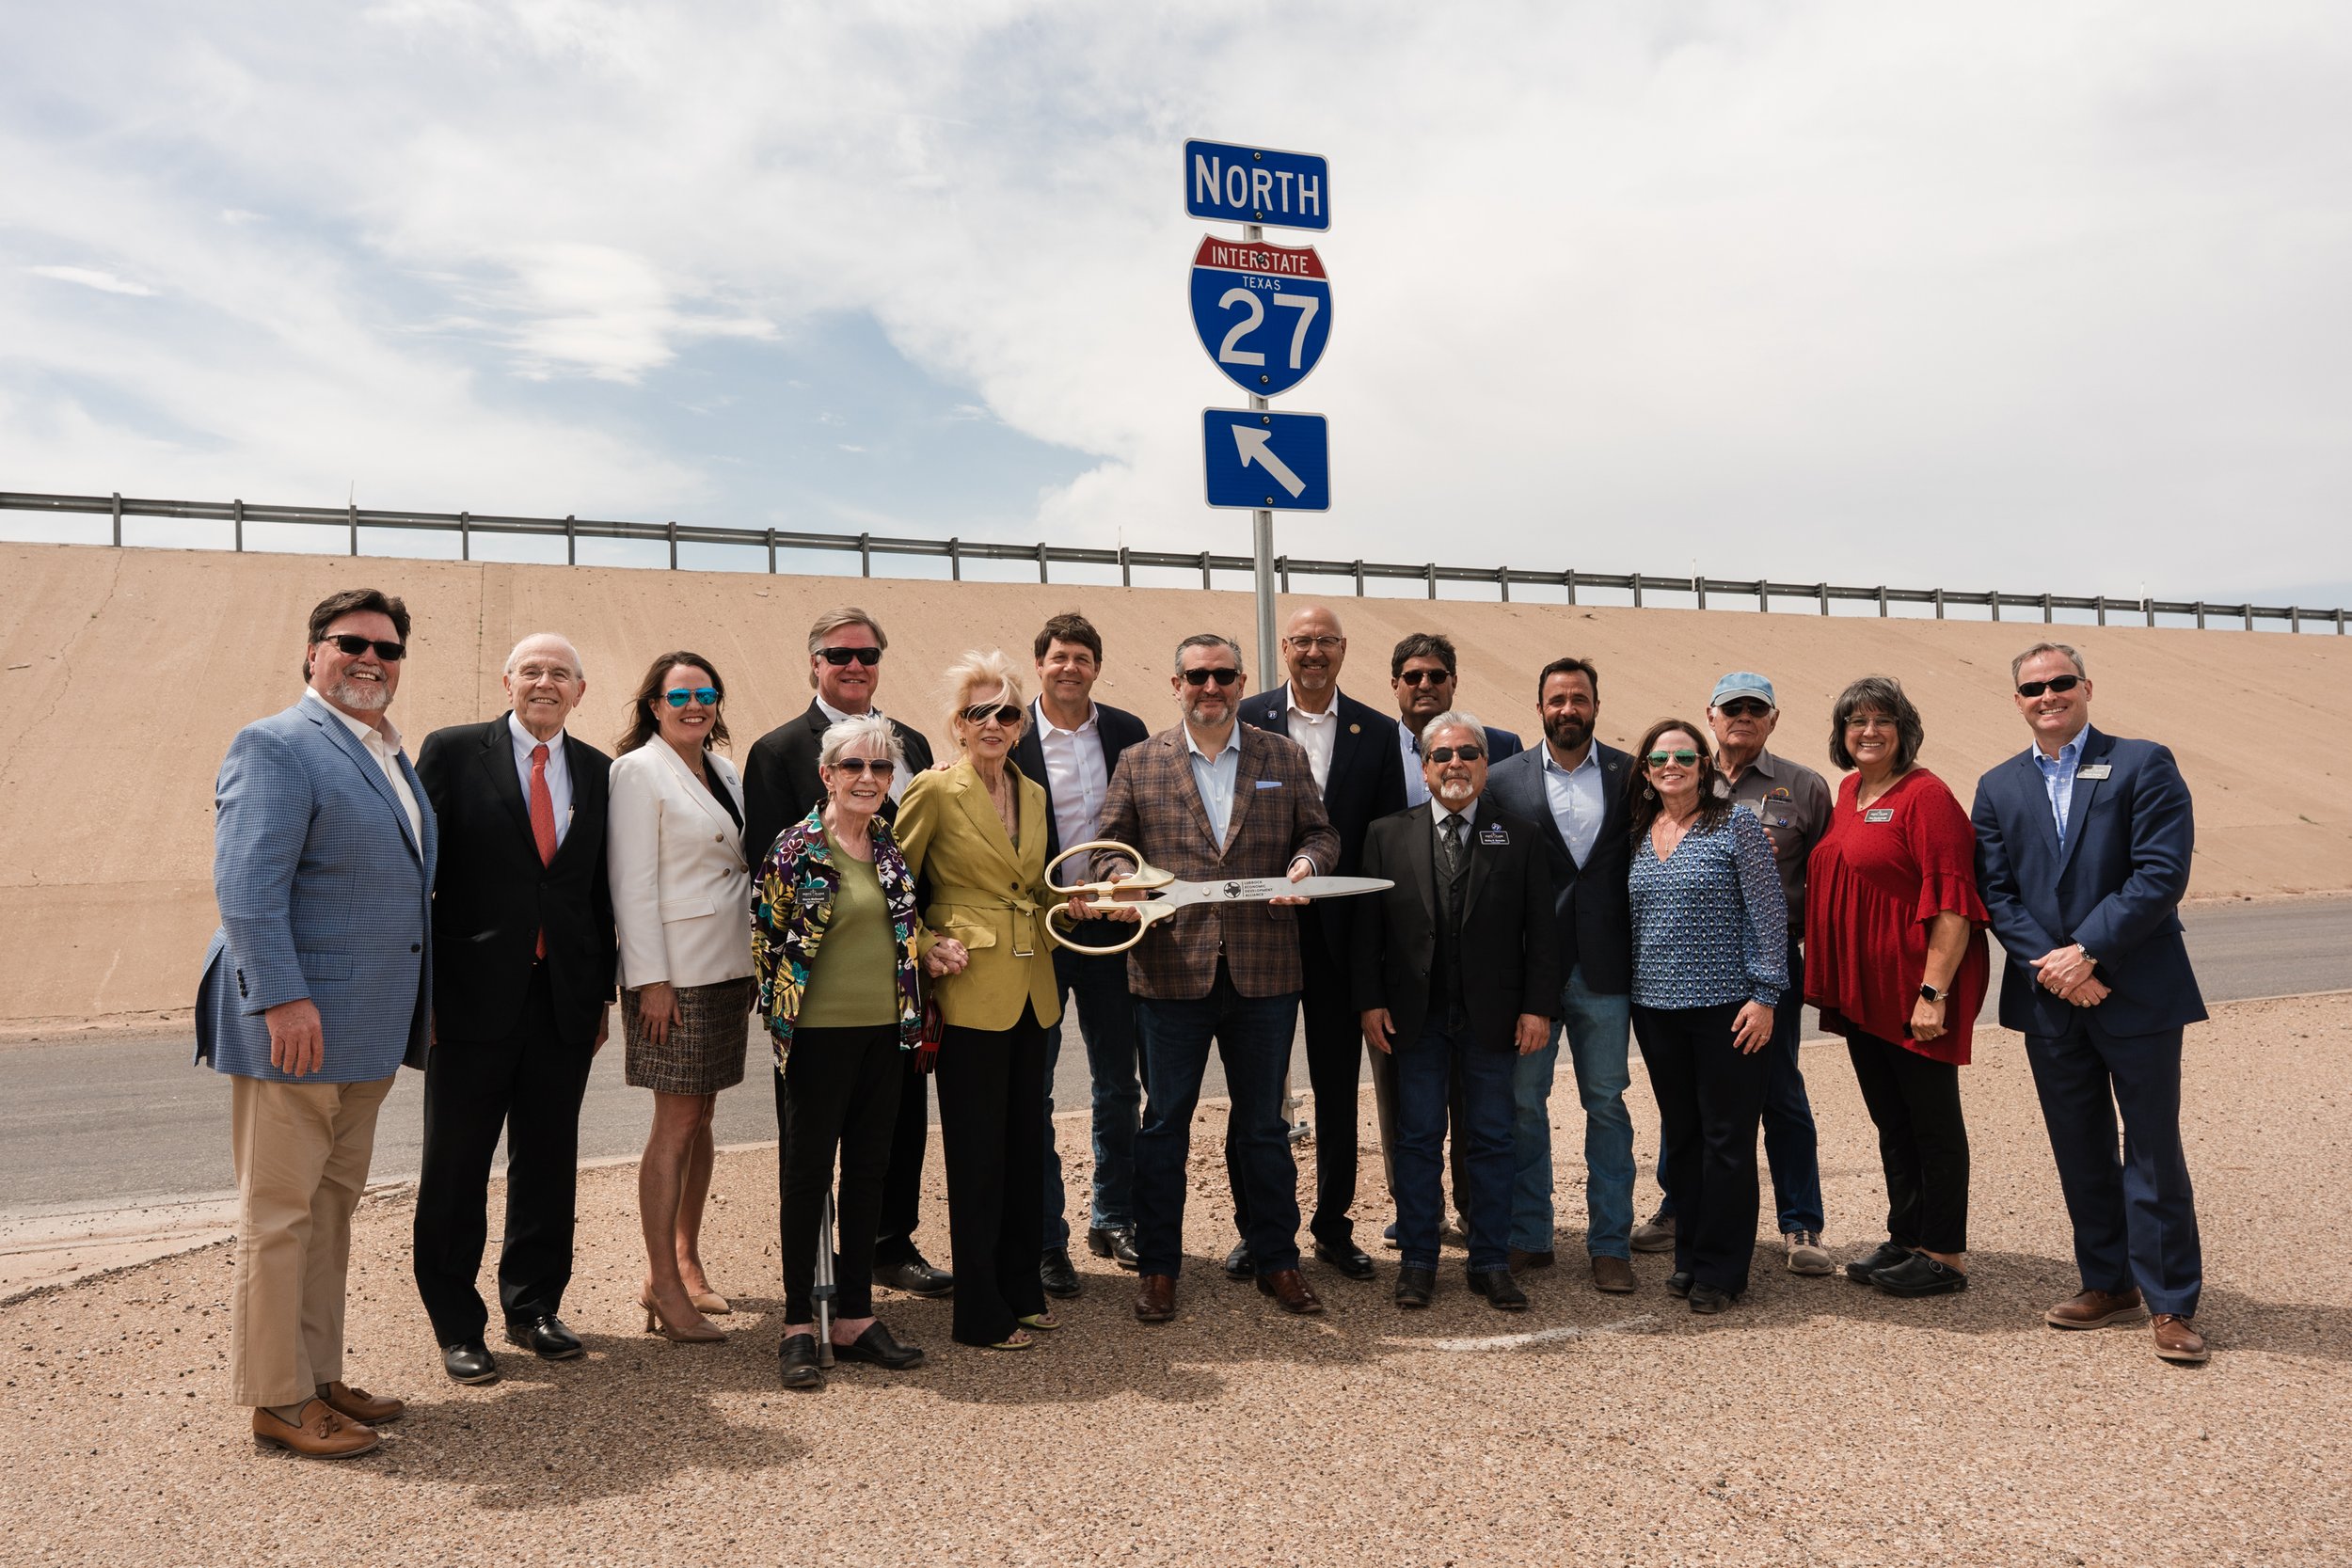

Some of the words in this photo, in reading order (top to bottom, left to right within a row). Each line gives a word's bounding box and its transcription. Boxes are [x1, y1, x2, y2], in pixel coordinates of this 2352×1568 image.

[1195, 154, 1319, 216] NORTH
[1212, 245, 1309, 274] INTERSTATE
[1243, 276, 1281, 291] TEXAS
[1218, 287, 1319, 370] 27
